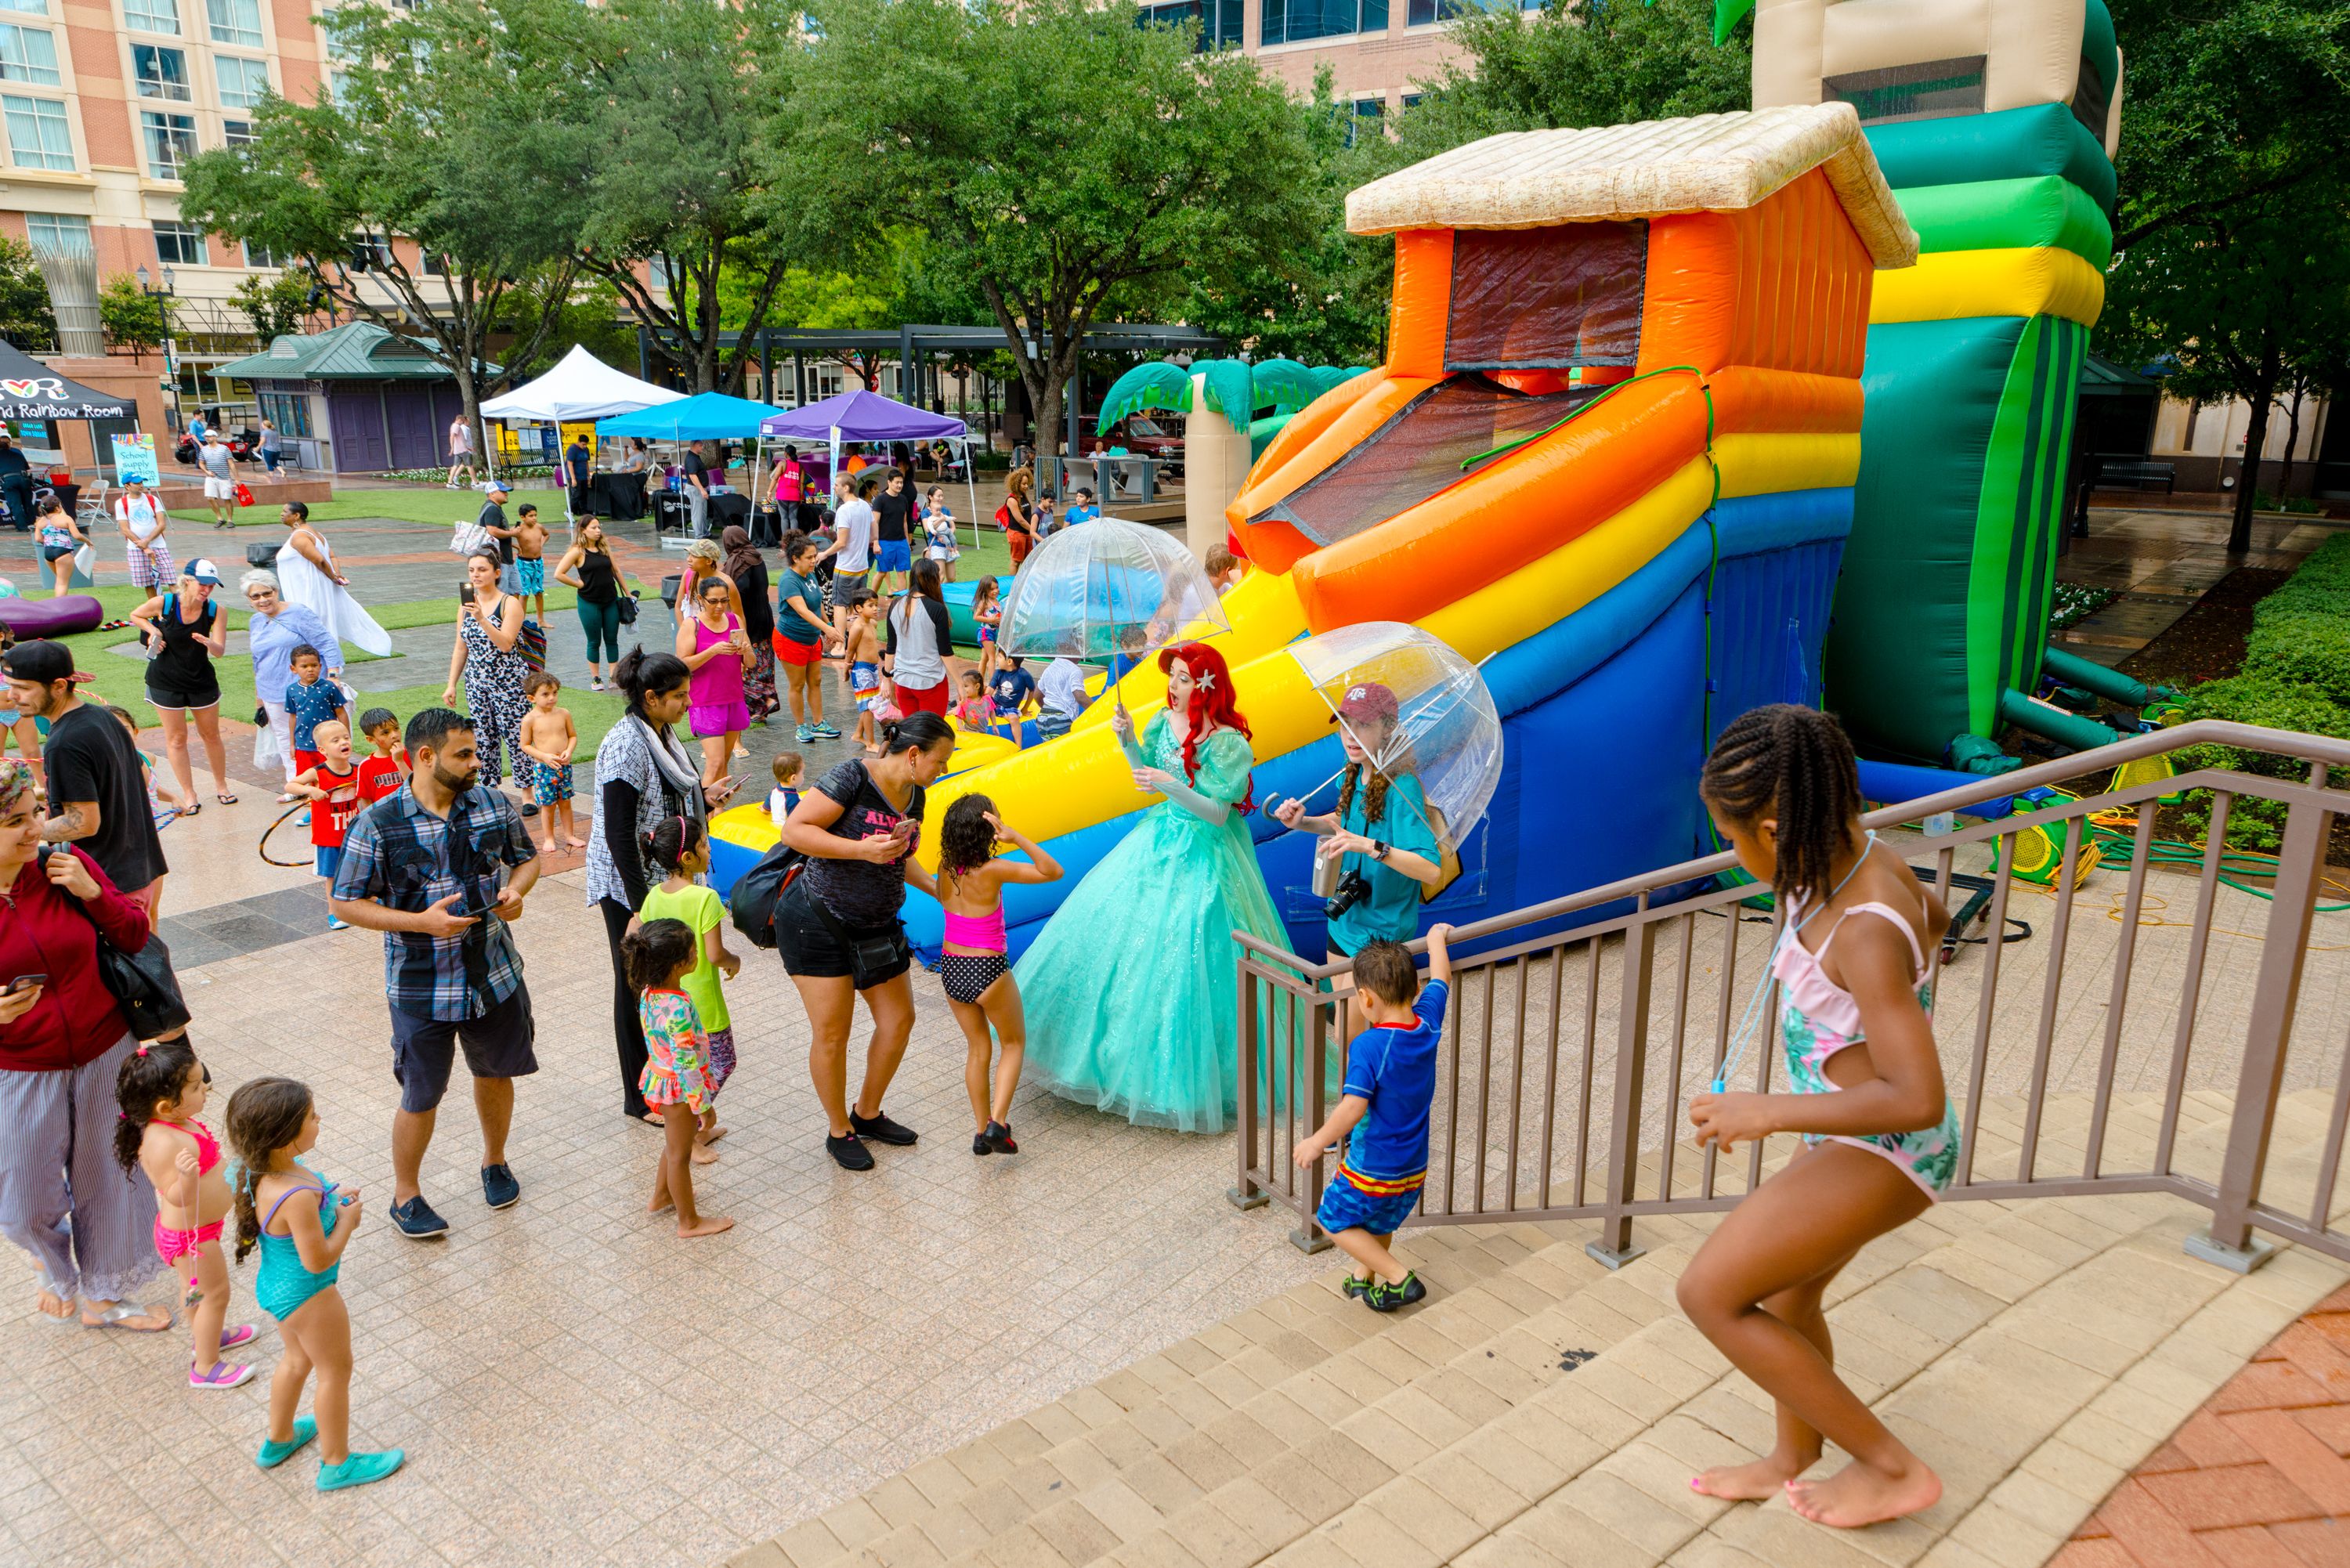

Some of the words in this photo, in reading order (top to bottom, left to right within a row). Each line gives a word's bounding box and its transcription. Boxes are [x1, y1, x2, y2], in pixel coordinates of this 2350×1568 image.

[19, 403, 78, 418] Rainbow
[82, 403, 124, 417] Room
[123, 461, 150, 470] supply
